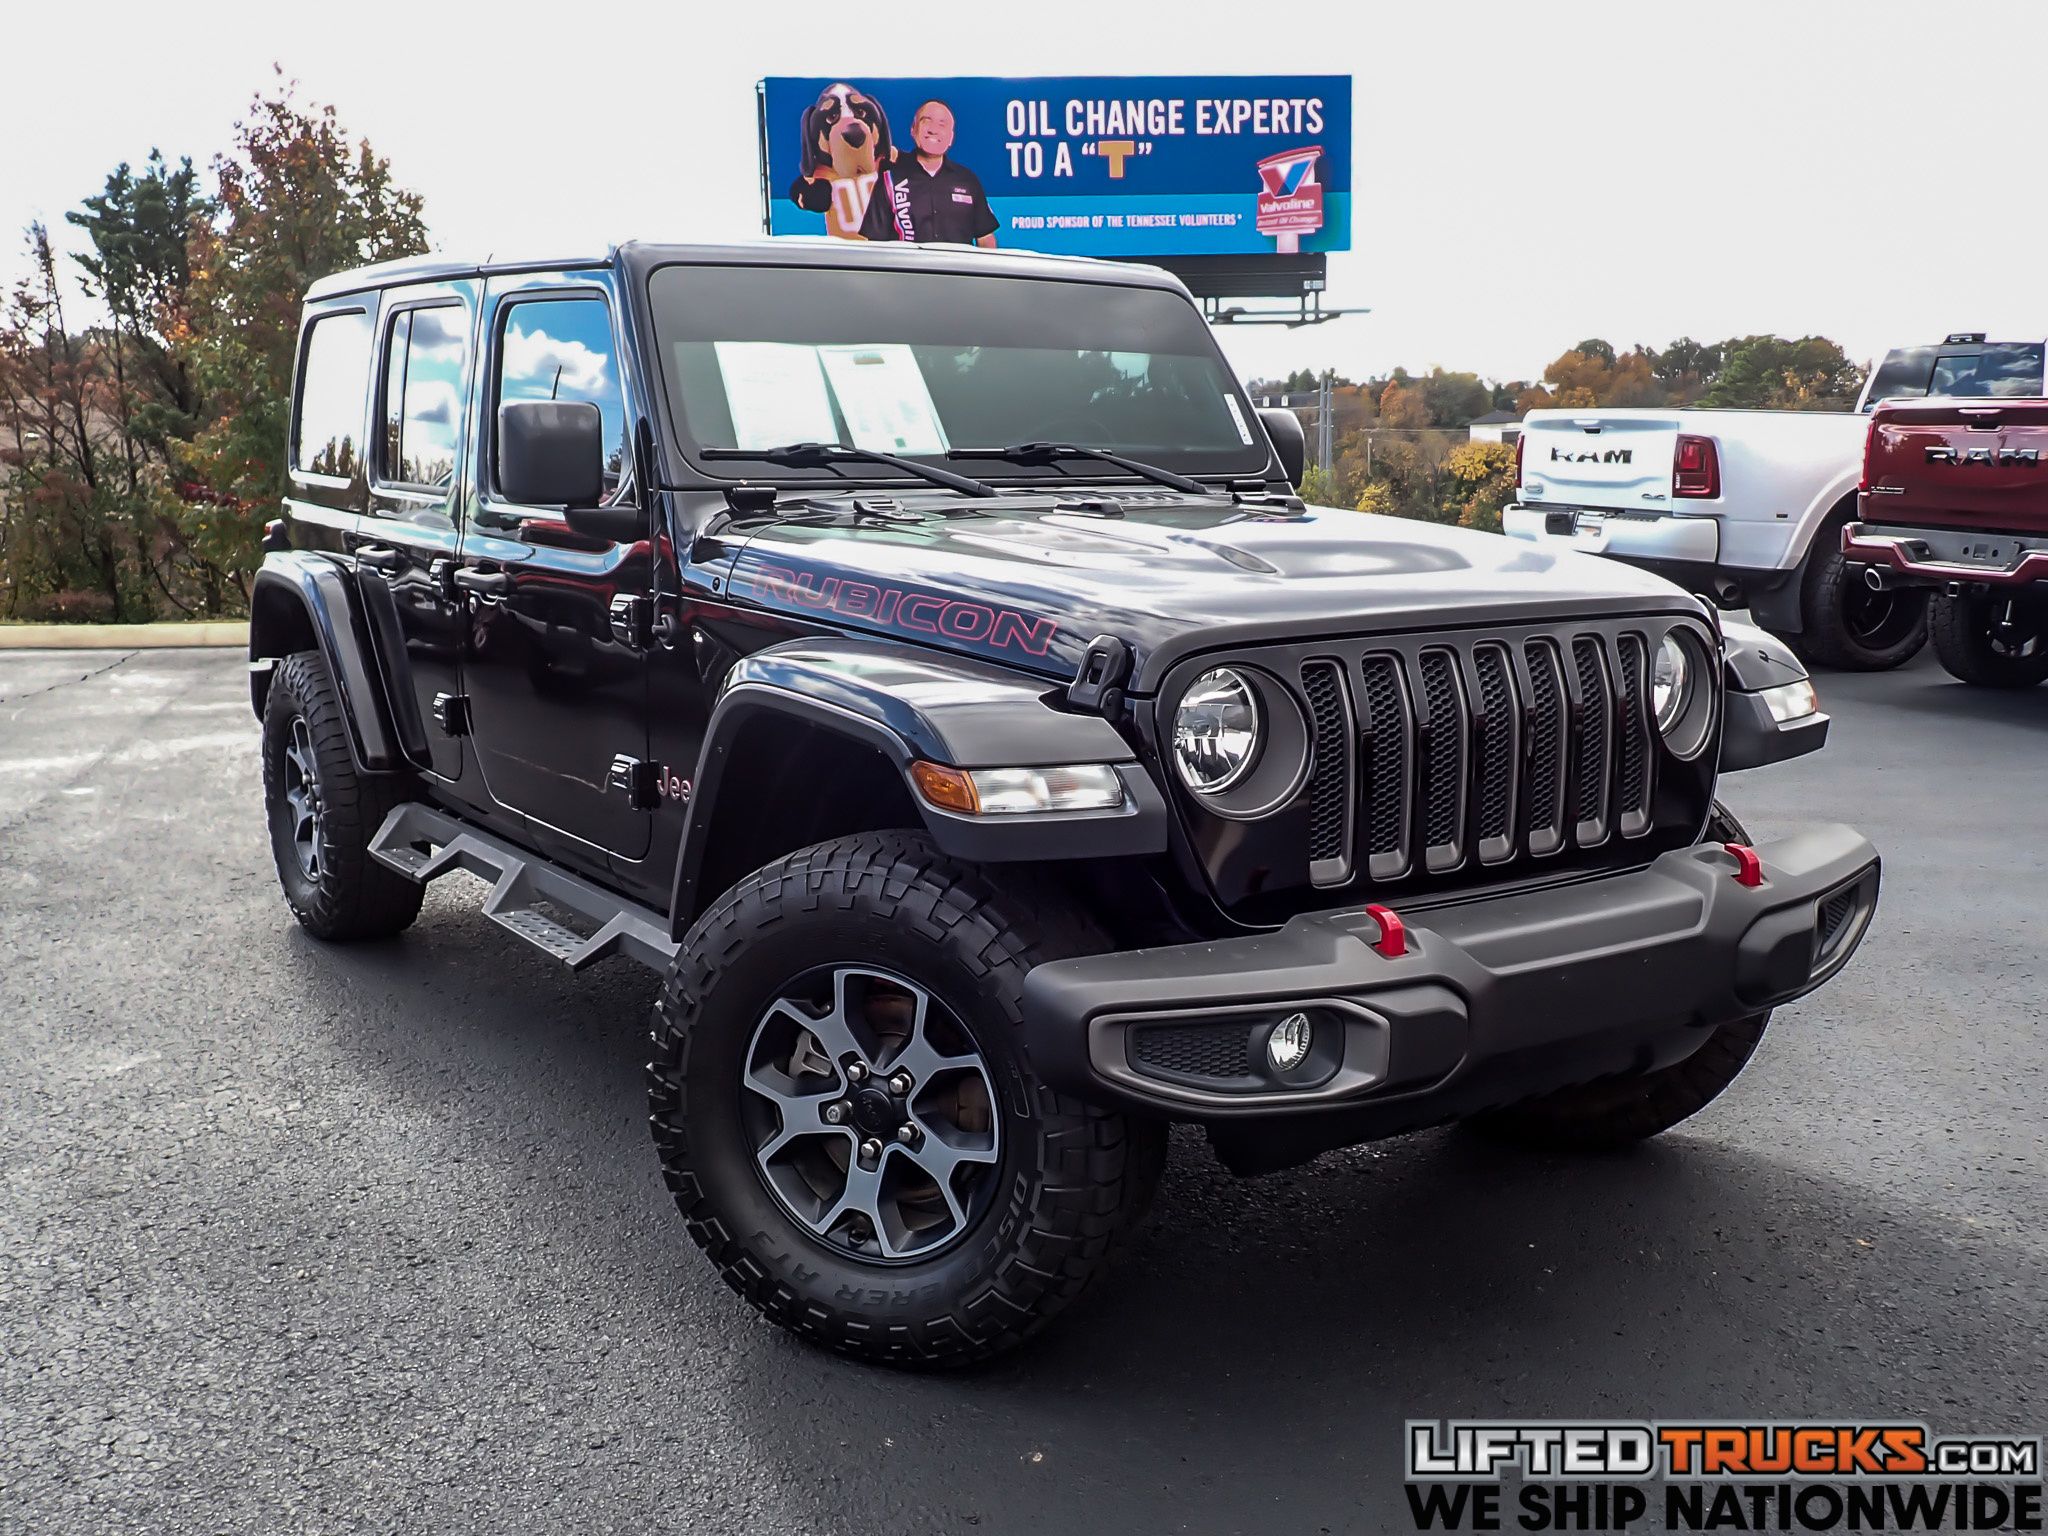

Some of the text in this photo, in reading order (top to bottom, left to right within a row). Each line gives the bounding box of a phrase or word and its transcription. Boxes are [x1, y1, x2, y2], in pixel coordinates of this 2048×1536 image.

[1006, 98, 1324, 136] OIL CHANGE EXPERTS
[1005, 141, 1043, 178] TO
[1053, 141, 1074, 177] A
[1260, 199, 1315, 213] Valvoline
[1012, 216, 1044, 229] PROUD
[1046, 216, 1090, 229] SPONSOR
[1092, 215, 1104, 228] OF
[1106, 215, 1124, 227] THE
[1126, 214, 1177, 227] TENNESSEE
[1551, 447, 1632, 464] RAM
[1924, 446, 2039, 466] RAM
[753, 565, 1059, 656] RUBICON
